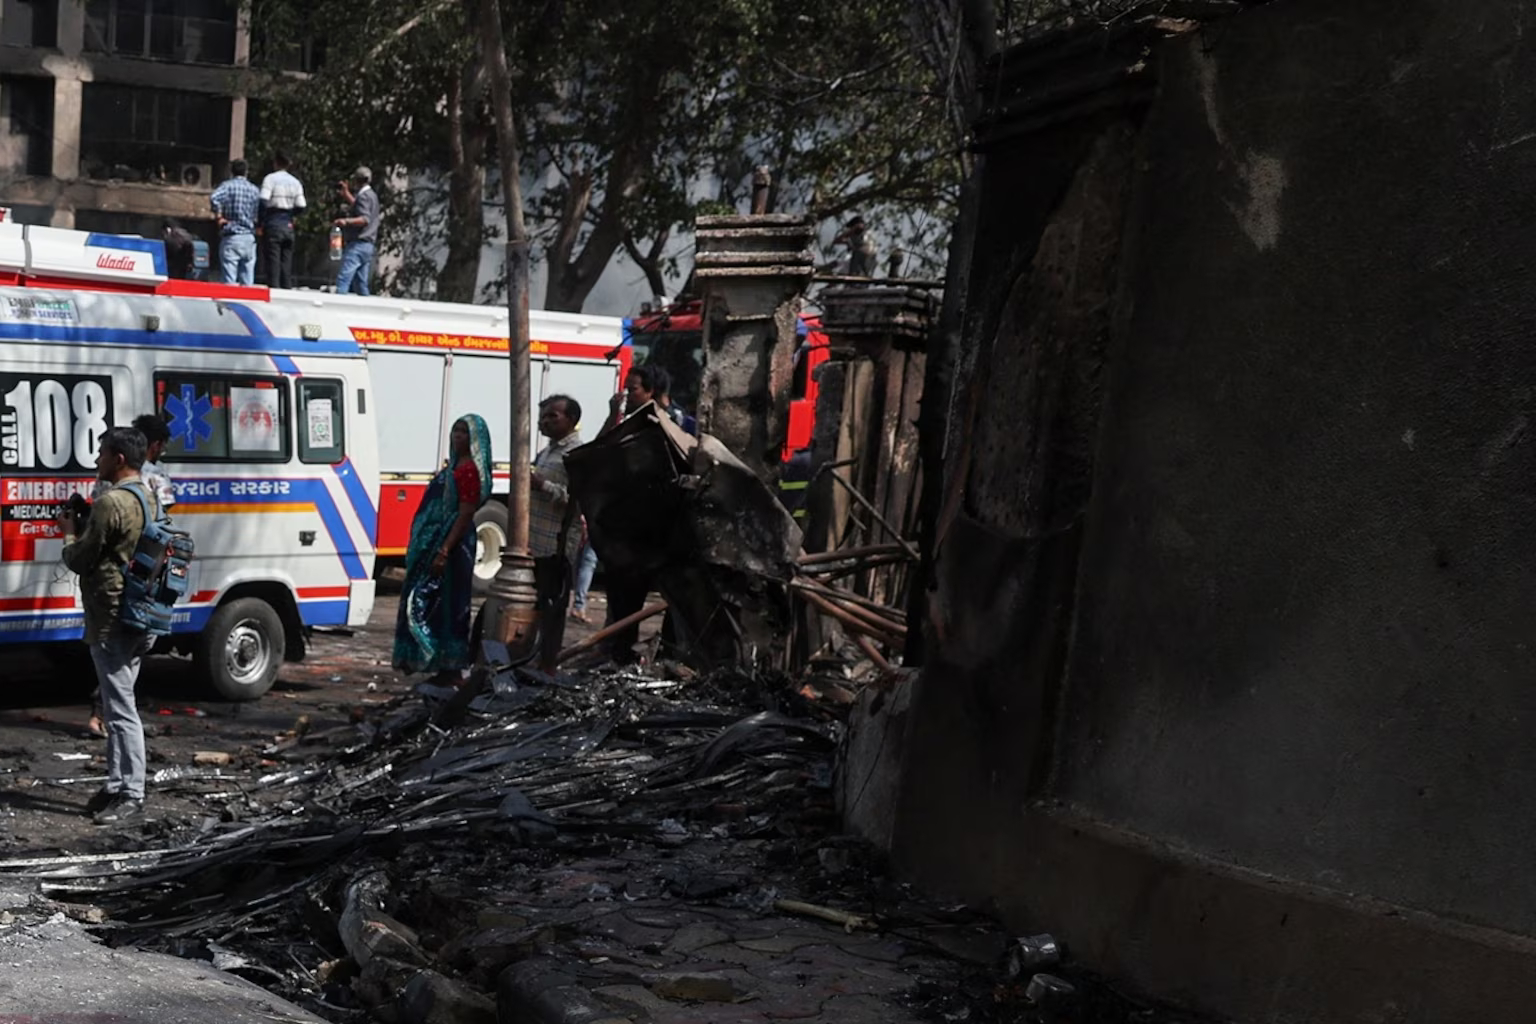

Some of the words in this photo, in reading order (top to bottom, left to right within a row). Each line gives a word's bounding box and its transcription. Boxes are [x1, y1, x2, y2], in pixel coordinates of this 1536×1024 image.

[1, 411, 18, 465] CALL
[4, 379, 108, 469] 108
[171, 481, 220, 496] જરાત
[230, 480, 291, 495] સરકાર
